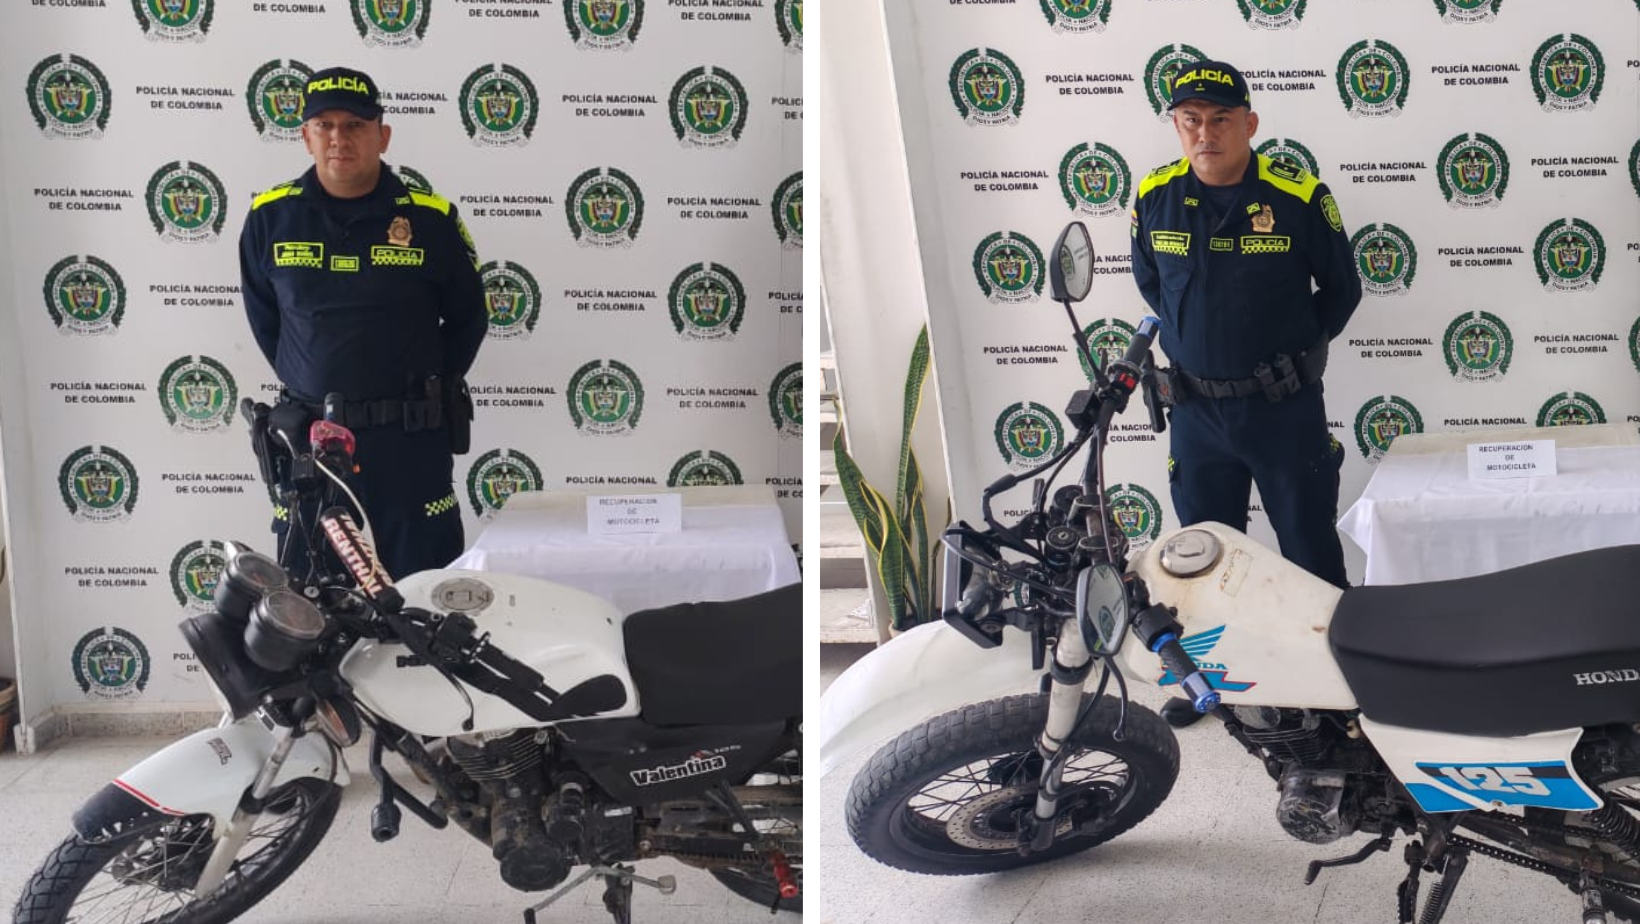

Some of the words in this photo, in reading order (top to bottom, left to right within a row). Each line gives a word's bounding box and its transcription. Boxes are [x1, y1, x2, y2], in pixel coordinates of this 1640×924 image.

[253, 3, 267, 11] DE
[271, 4, 325, 13] COLOMBIA
[469, 9, 482, 17] DE
[485, 9, 539, 18] COLOMBIA
[681, 12, 694, 20] DE
[698, 12, 751, 21] COLOMBIA
[1432, 64, 1469, 73] POLICÍA
[1472, 64, 1520, 72] NACIONAL
[1046, 74, 1083, 83] POLICÍA
[1086, 74, 1134, 82] NACIONAL
[1175, 68, 1234, 89] POLICÍA
[1278, 70, 1326, 78] NACIONAL
[1459, 76, 1509, 85] COLOMBIA
[307, 77, 368, 95] POLICÍA
[1252, 84, 1264, 92] DE
[1267, 83, 1315, 91] COLOMBIA
[136, 86, 178, 95] POLICÍA
[181, 88, 235, 96] NACIONAL
[396, 93, 447, 101] NACIONAL
[562, 94, 603, 103] POLICÍA
[606, 95, 657, 103] NACIONAL
[167, 101, 222, 110] COLOMBIA
[576, 108, 589, 116] DE
[592, 109, 645, 117] COLOMBIA
[785, 111, 798, 119] DE
[1531, 157, 1568, 166] POLICÍA
[1571, 156, 1619, 164] NACIONAL
[1340, 162, 1377, 171] POLICÍA
[1379, 162, 1427, 170] NACIONAL
[960, 171, 998, 180] POLICÍA
[1367, 174, 1416, 182] COLOMBIA
[1543, 170, 1555, 178] DE
[1558, 169, 1607, 177] COLOMBIA
[989, 183, 1038, 191] COLOMBIA
[34, 187, 77, 197] POLICÍA
[80, 189, 133, 198] NACIONAL
[460, 195, 500, 203] POLICÍA
[503, 196, 553, 204] NACIONAL
[668, 197, 707, 205] POLICÍA
[710, 198, 762, 206] NACIONAL
[49, 202, 63, 210] DE
[66, 202, 122, 210] COLOMBIA
[490, 209, 542, 217] COLOMBIA
[696, 211, 748, 219] COLOMBIA
[1245, 237, 1285, 247] POLICÍA
[1438, 247, 1475, 255] POLICÍA
[1477, 246, 1524, 254] NACIONAL
[1464, 258, 1512, 266] COLOMBIA
[150, 285, 191, 293] POLICÍA
[564, 290, 604, 298] POLICÍA
[181, 298, 234, 306] COLOMBIA
[577, 303, 589, 311] DE
[593, 303, 645, 311] COLOMBIA
[780, 305, 793, 313] DE
[1349, 338, 1385, 346] POLICÍA
[1388, 338, 1433, 346] NACIONAL
[1534, 334, 1570, 342] POLICÍA
[1573, 334, 1619, 342] NACIONAL
[983, 346, 1020, 354] POLICÍA
[1022, 345, 1068, 353] NACIONAL
[50, 381, 92, 390] POLICÍA
[506, 386, 556, 394] NACIONAL
[667, 388, 705, 396] POLICÍA
[709, 388, 760, 396] NACIONAL
[65, 395, 79, 403] DE
[81, 395, 135, 403] COLOMBIA
[476, 399, 489, 407] DE
[493, 399, 544, 407] COLOMBIA
[695, 401, 747, 409] COLOMBIA
[1444, 418, 1479, 426] POLICÍA
[1486, 462, 1536, 471] MOTOCICLETA
[566, 476, 605, 484] POLICÍA
[777, 490, 788, 498] DE
[65, 566, 105, 575] POLICÍA
[78, 579, 91, 587] DE
[95, 579, 147, 587] COLOMBIA
[1572, 669, 1640, 686] HOND
[630, 755, 727, 786] Valentina
[1438, 766, 1552, 796] 125
